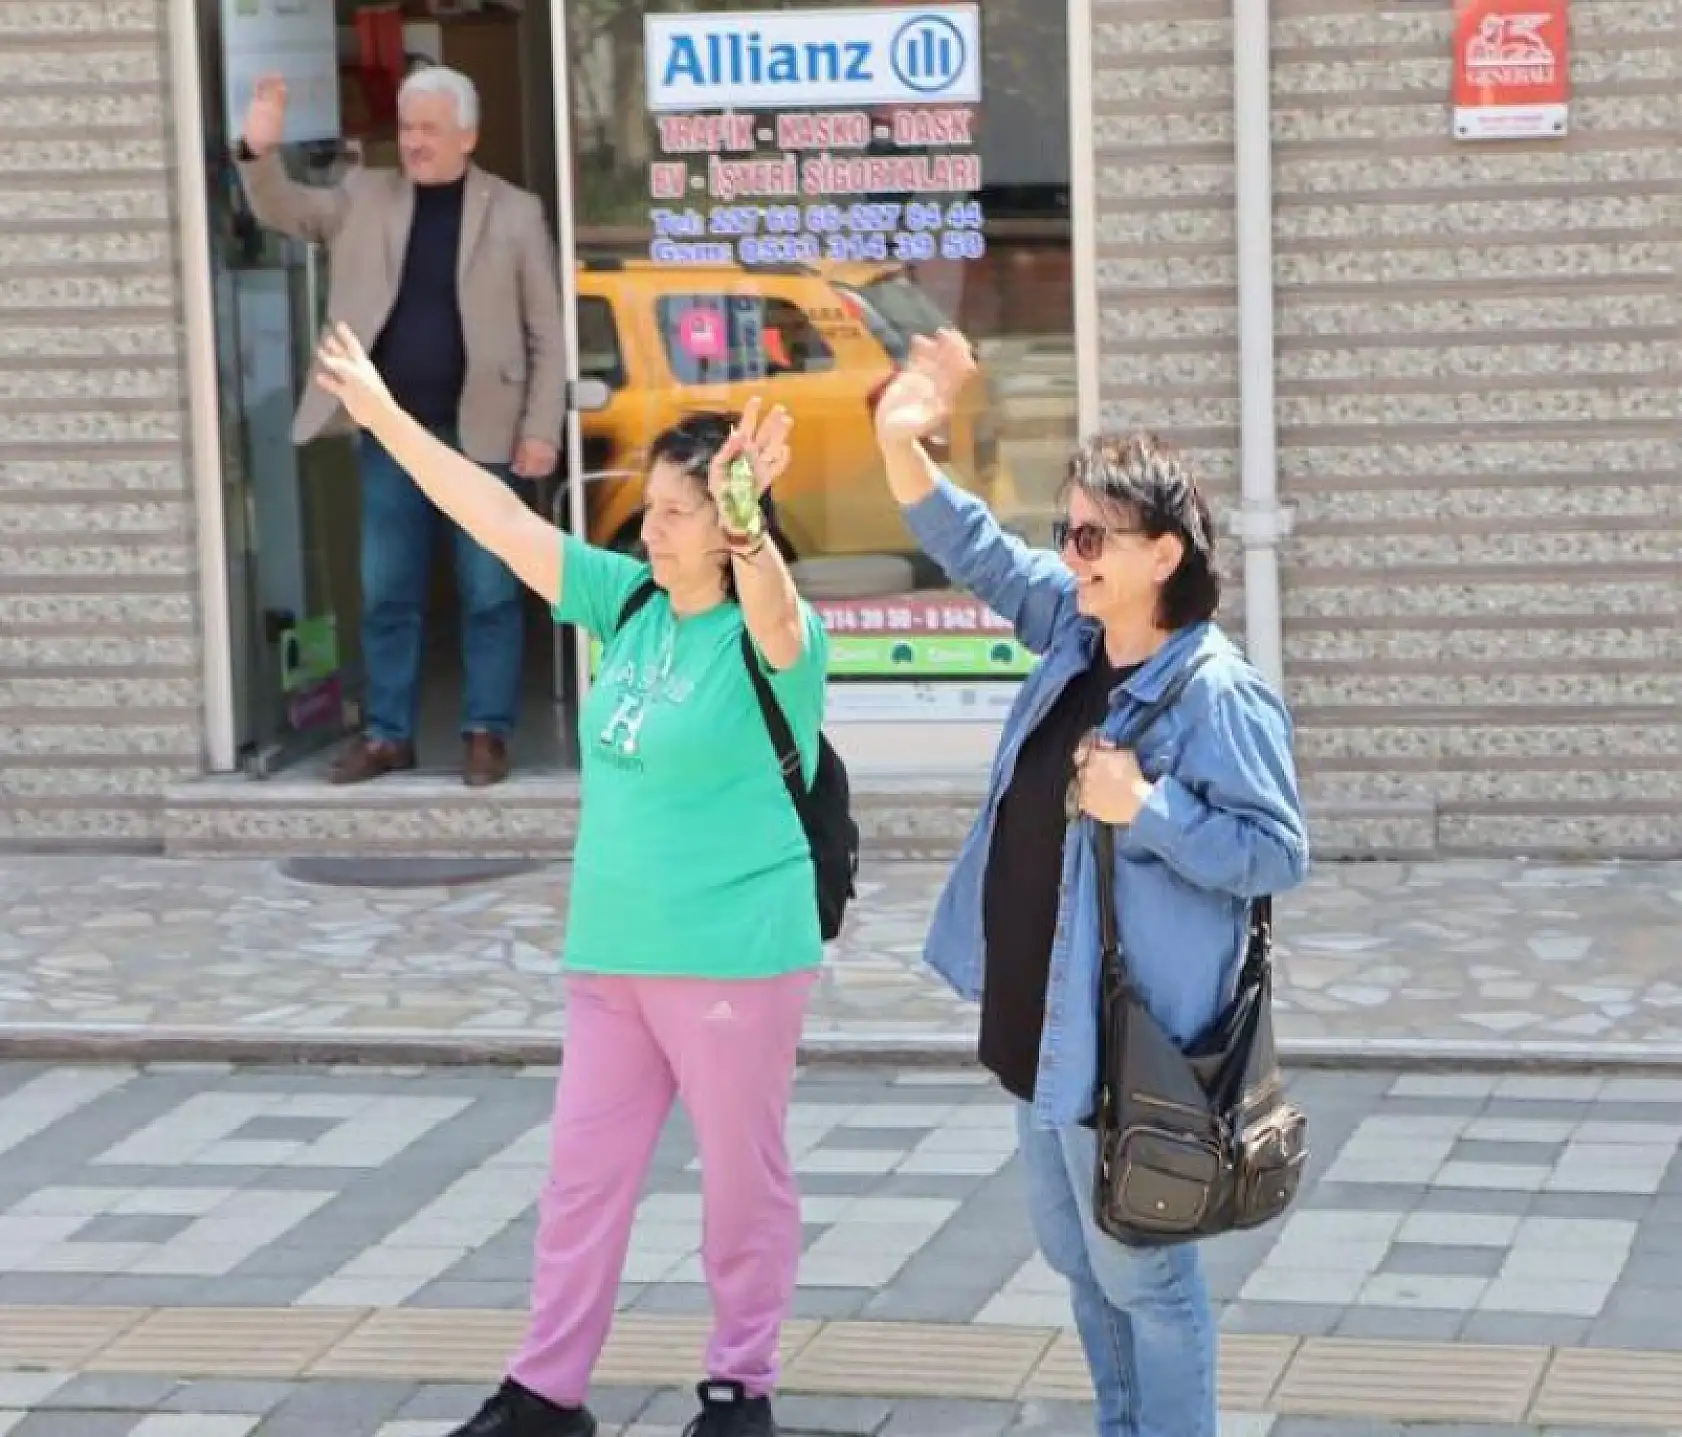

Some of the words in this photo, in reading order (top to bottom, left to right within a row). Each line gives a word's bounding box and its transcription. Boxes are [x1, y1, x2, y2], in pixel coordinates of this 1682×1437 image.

[661, 31, 874, 87] Allianz
[1465, 66, 1553, 86] GENERALI
[661, 112, 756, 153] TRAFİK
[757, 126, 774, 142] -
[776, 113, 871, 151] KASKO
[873, 125, 890, 140] -
[892, 109, 974, 146] DASK
[651, 161, 687, 199] EV
[690, 174, 706, 190] -
[708, 152, 798, 202] İŞYERİ
